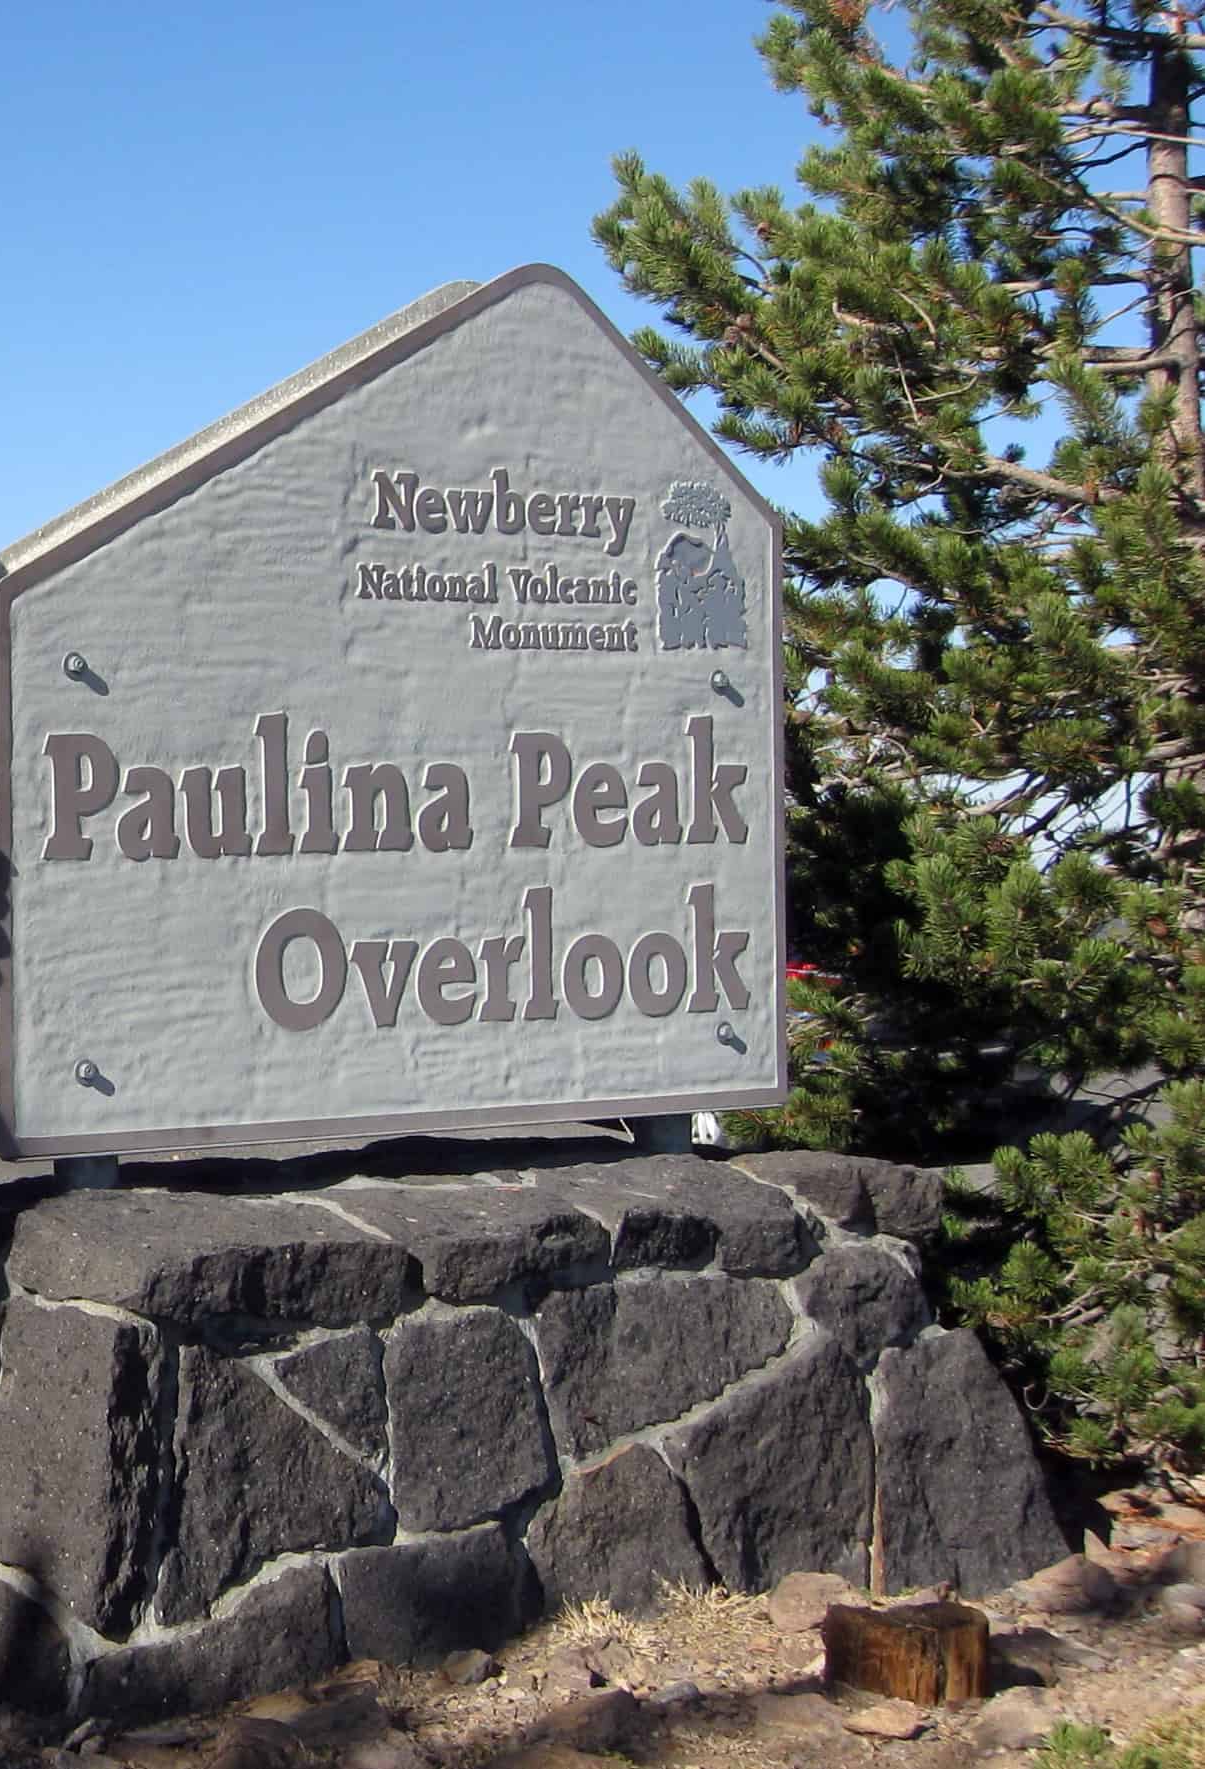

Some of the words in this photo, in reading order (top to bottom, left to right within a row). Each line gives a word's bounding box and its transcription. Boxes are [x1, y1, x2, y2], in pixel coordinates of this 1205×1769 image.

[371, 467, 636, 557] Newberry
[356, 562, 498, 604] National
[507, 563, 639, 606] Volcanic
[470, 614, 639, 652] Monument
[42, 709, 474, 863] Paulina
[508, 713, 749, 850] Peak
[252, 881, 752, 1032] Overlook
